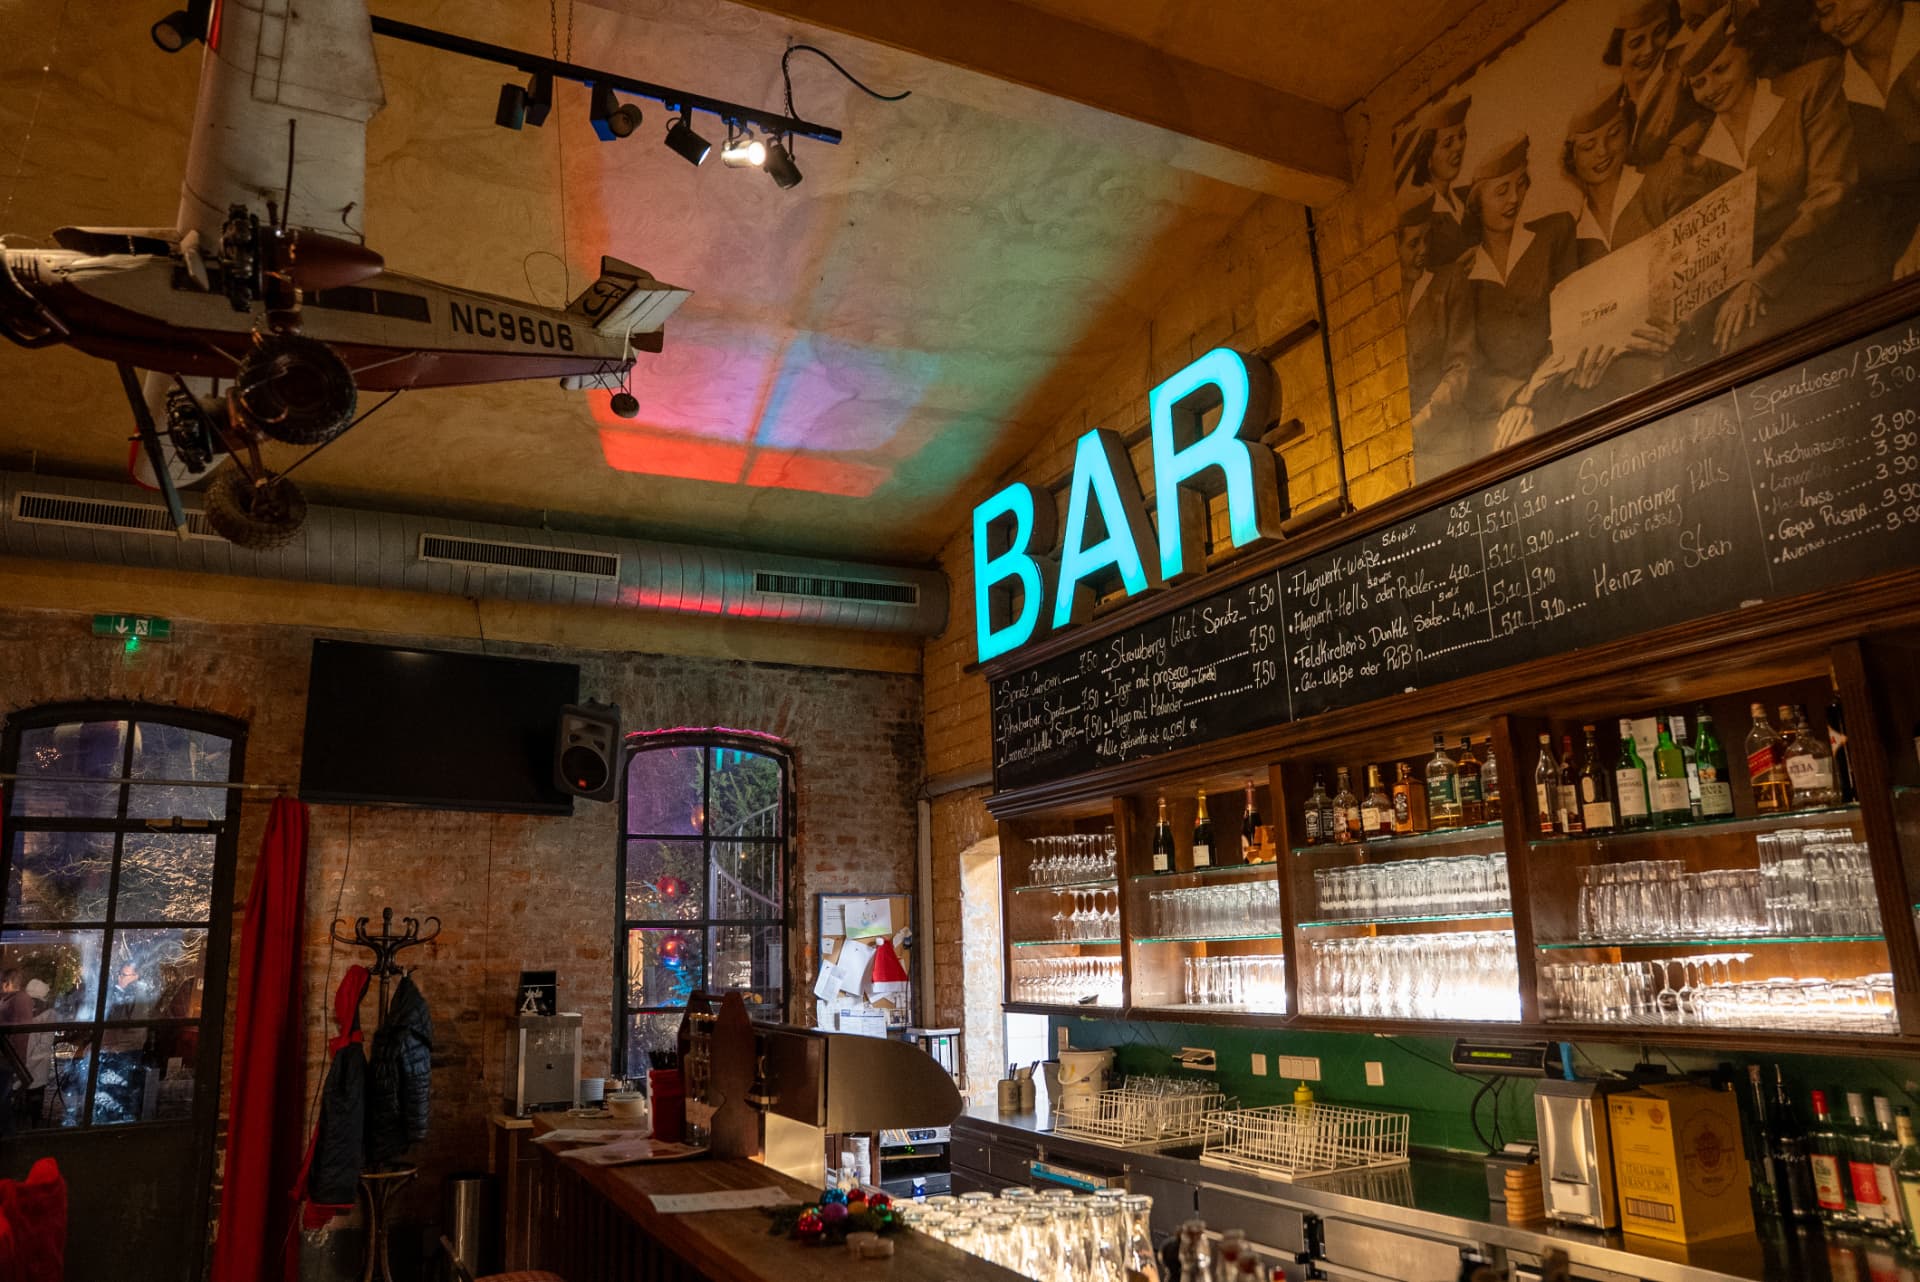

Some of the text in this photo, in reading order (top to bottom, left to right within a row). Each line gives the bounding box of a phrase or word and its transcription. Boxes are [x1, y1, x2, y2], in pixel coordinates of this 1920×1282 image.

[1696, 197, 1730, 228] York
[450, 301, 574, 351] NC9606
[973, 347, 1261, 663] BAR
[1592, 522, 1732, 599] Heinz von Stein
[1375, 583, 1397, 604] oder
[1359, 661, 1381, 677] oder
